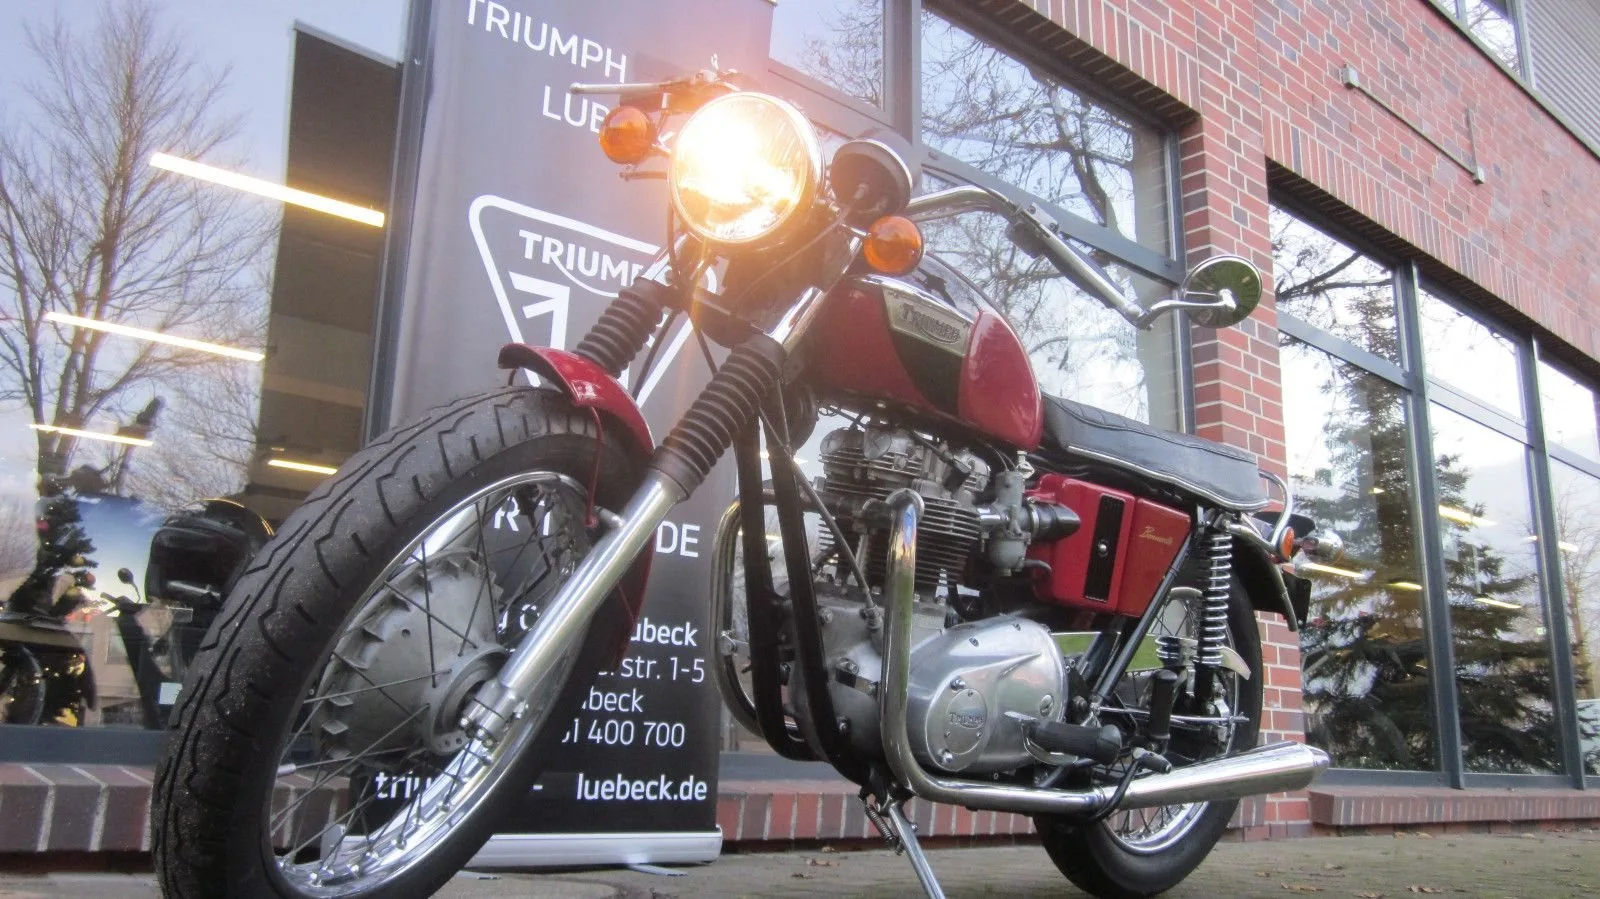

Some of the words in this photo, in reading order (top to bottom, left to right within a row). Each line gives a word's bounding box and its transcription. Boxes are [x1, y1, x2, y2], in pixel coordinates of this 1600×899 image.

[467, 0, 627, 84] TRIUMPH
[518, 229, 643, 289] TRIUM
[630, 617, 699, 647] ubeck
[669, 656, 705, 683] 1-5
[582, 685, 644, 713] beck
[587, 719, 635, 745] 400
[643, 721, 686, 747] 700
[576, 772, 707, 801] luebeck.de
